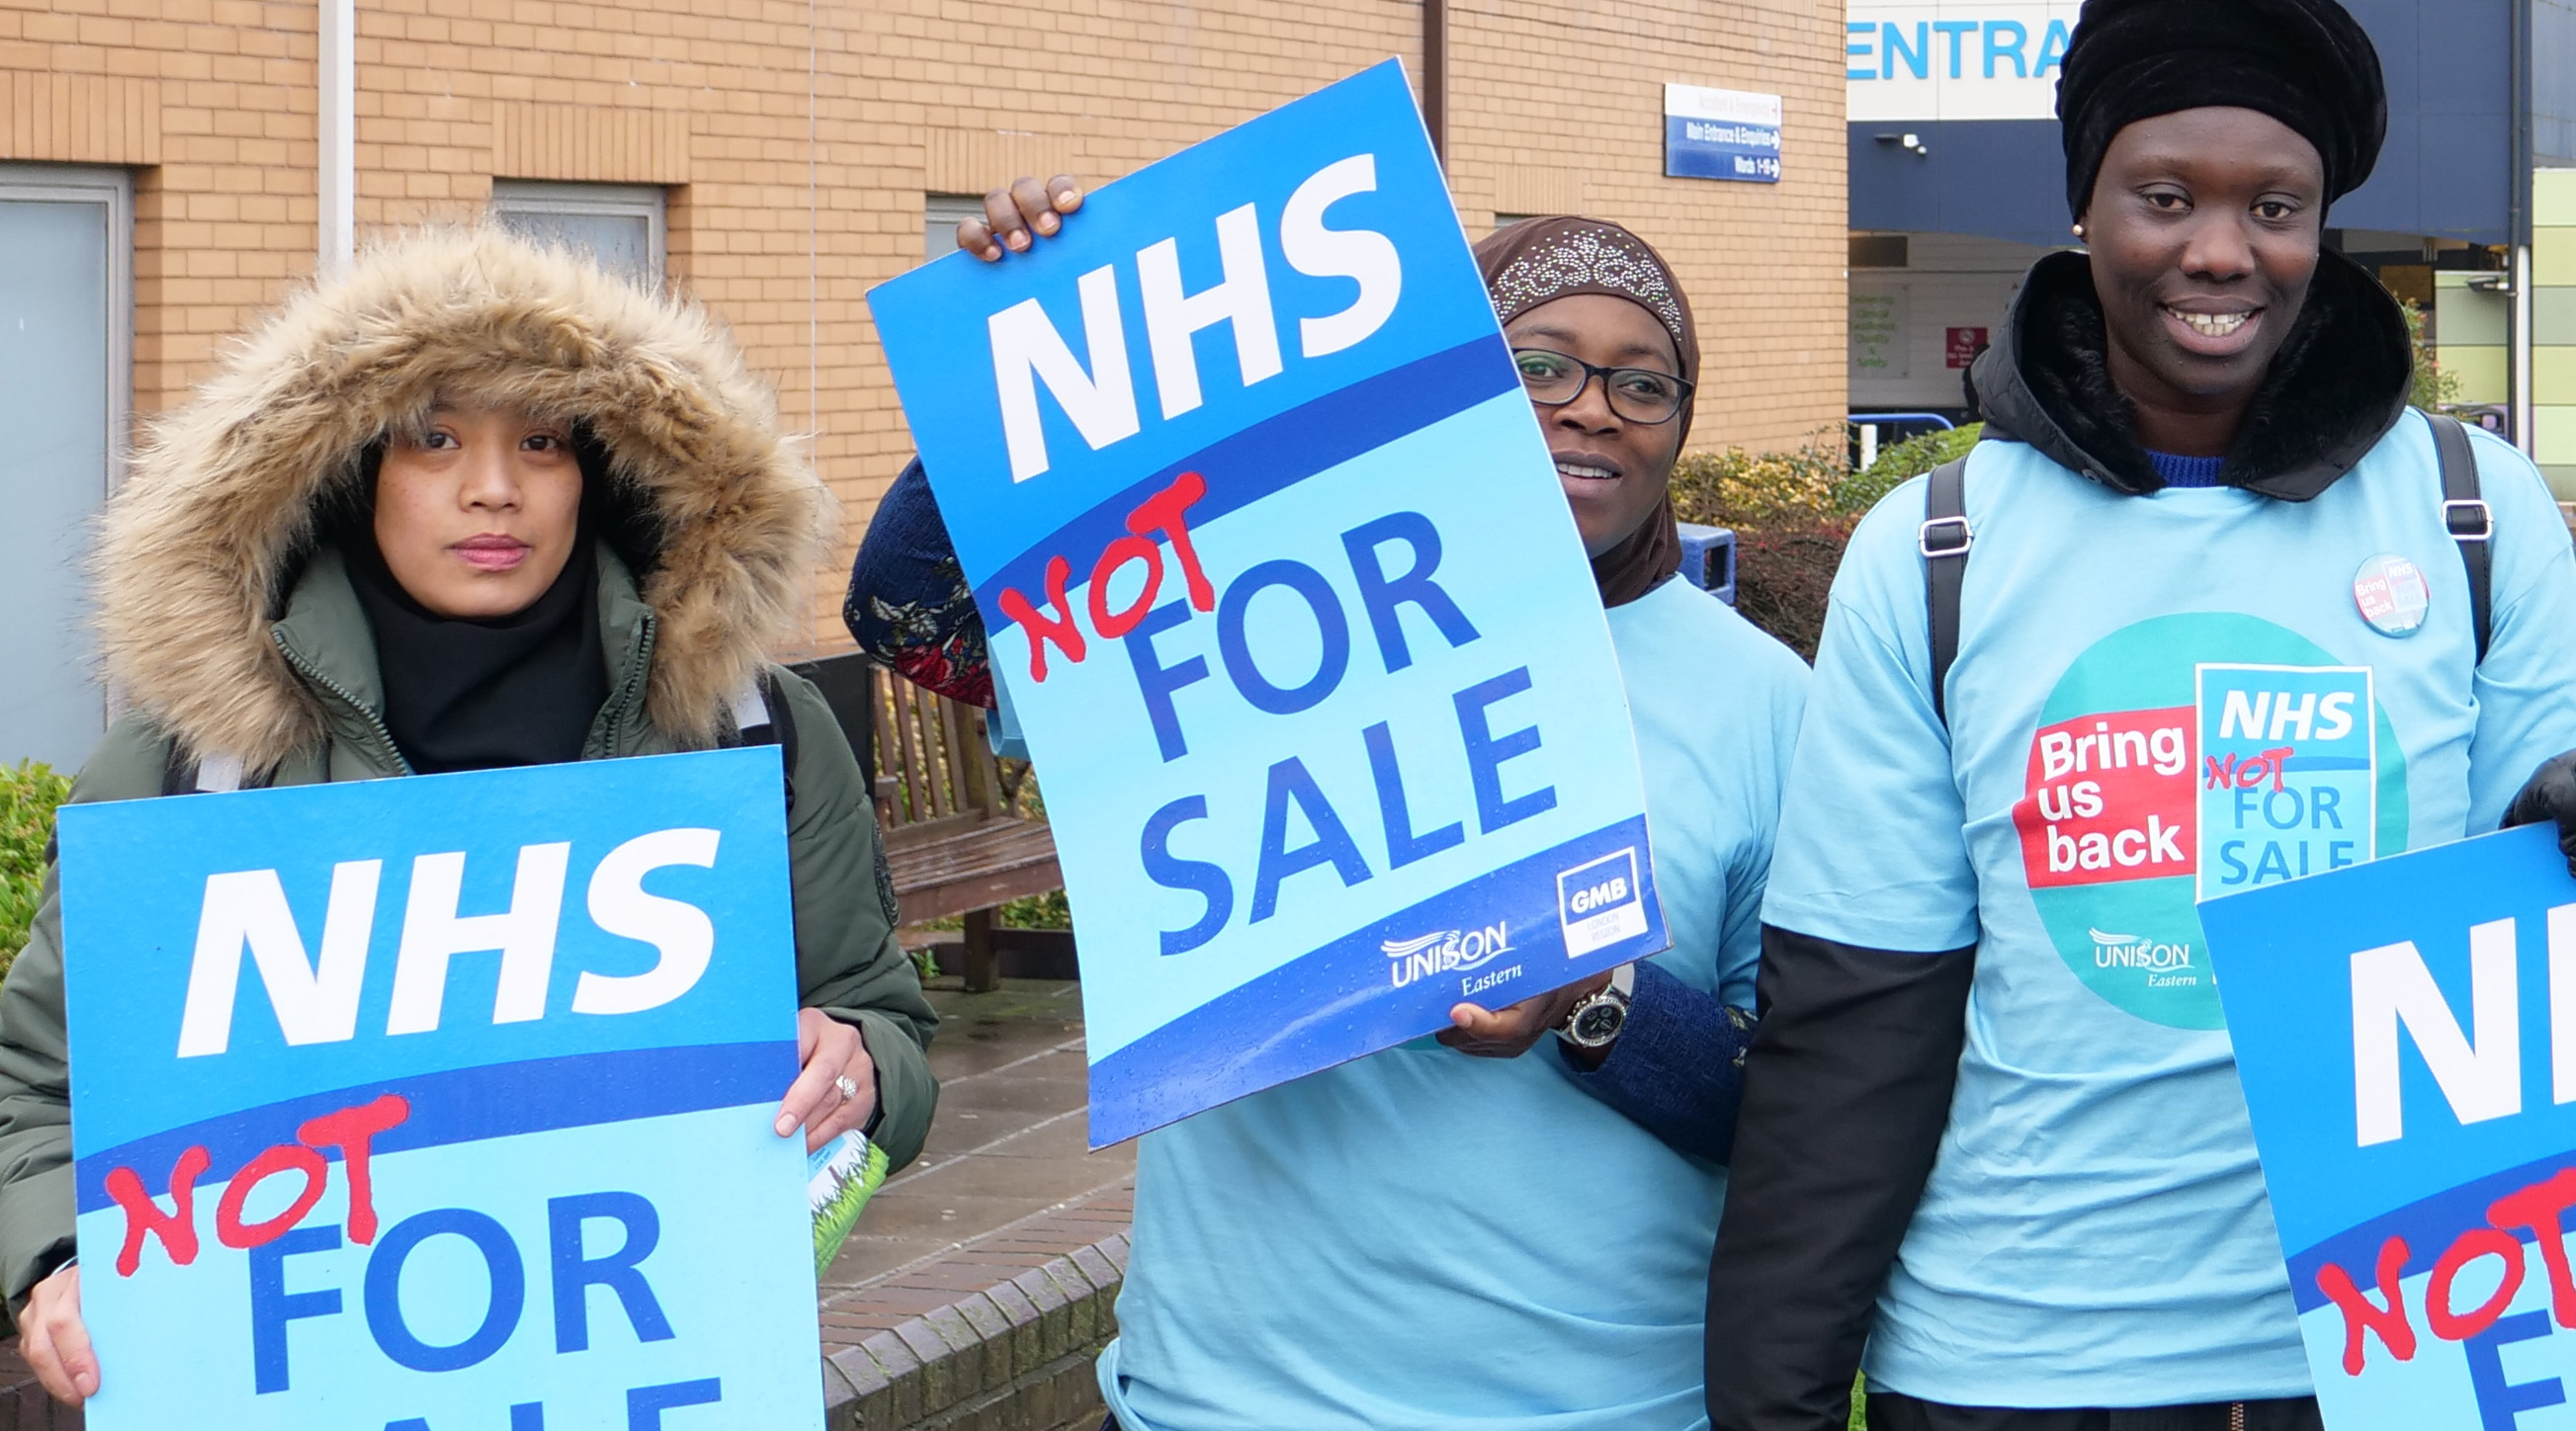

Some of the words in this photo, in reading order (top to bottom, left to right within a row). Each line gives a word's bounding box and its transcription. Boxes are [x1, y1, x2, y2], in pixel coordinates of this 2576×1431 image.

[1686, 121, 1704, 140] Main
[1704, 123, 1735, 144] Entrance
[1741, 126, 1771, 148] Enquiries
[1734, 155, 1756, 175] Wards
[987, 152, 1403, 483] NHS
[998, 471, 1215, 683] NOT
[2356, 578, 2387, 597] Bring
[2387, 562, 2414, 578] NHS
[2362, 595, 2376, 607] us
[2365, 599, 2394, 619] back
[1123, 510, 1482, 764] FOR
[2218, 689, 2356, 741] NHS
[2039, 721, 2188, 782] Bring
[2205, 745, 2295, 794] NOT
[1140, 664, 1558, 957] SALE
[2037, 779, 2104, 821] us
[2233, 785, 2344, 830] FOR
[2047, 814, 2187, 874] back
[1571, 877, 1628, 914] GMB
[177, 827, 722, 1058] NHS
[1390, 919, 1507, 988] UNISON
[2095, 942, 2190, 968] UNISON
[1461, 964, 1523, 997] Eastern
[2147, 973, 2197, 987] Eastern
[105, 1094, 409, 1278] NOT
[248, 1191, 676, 1394] FOR
